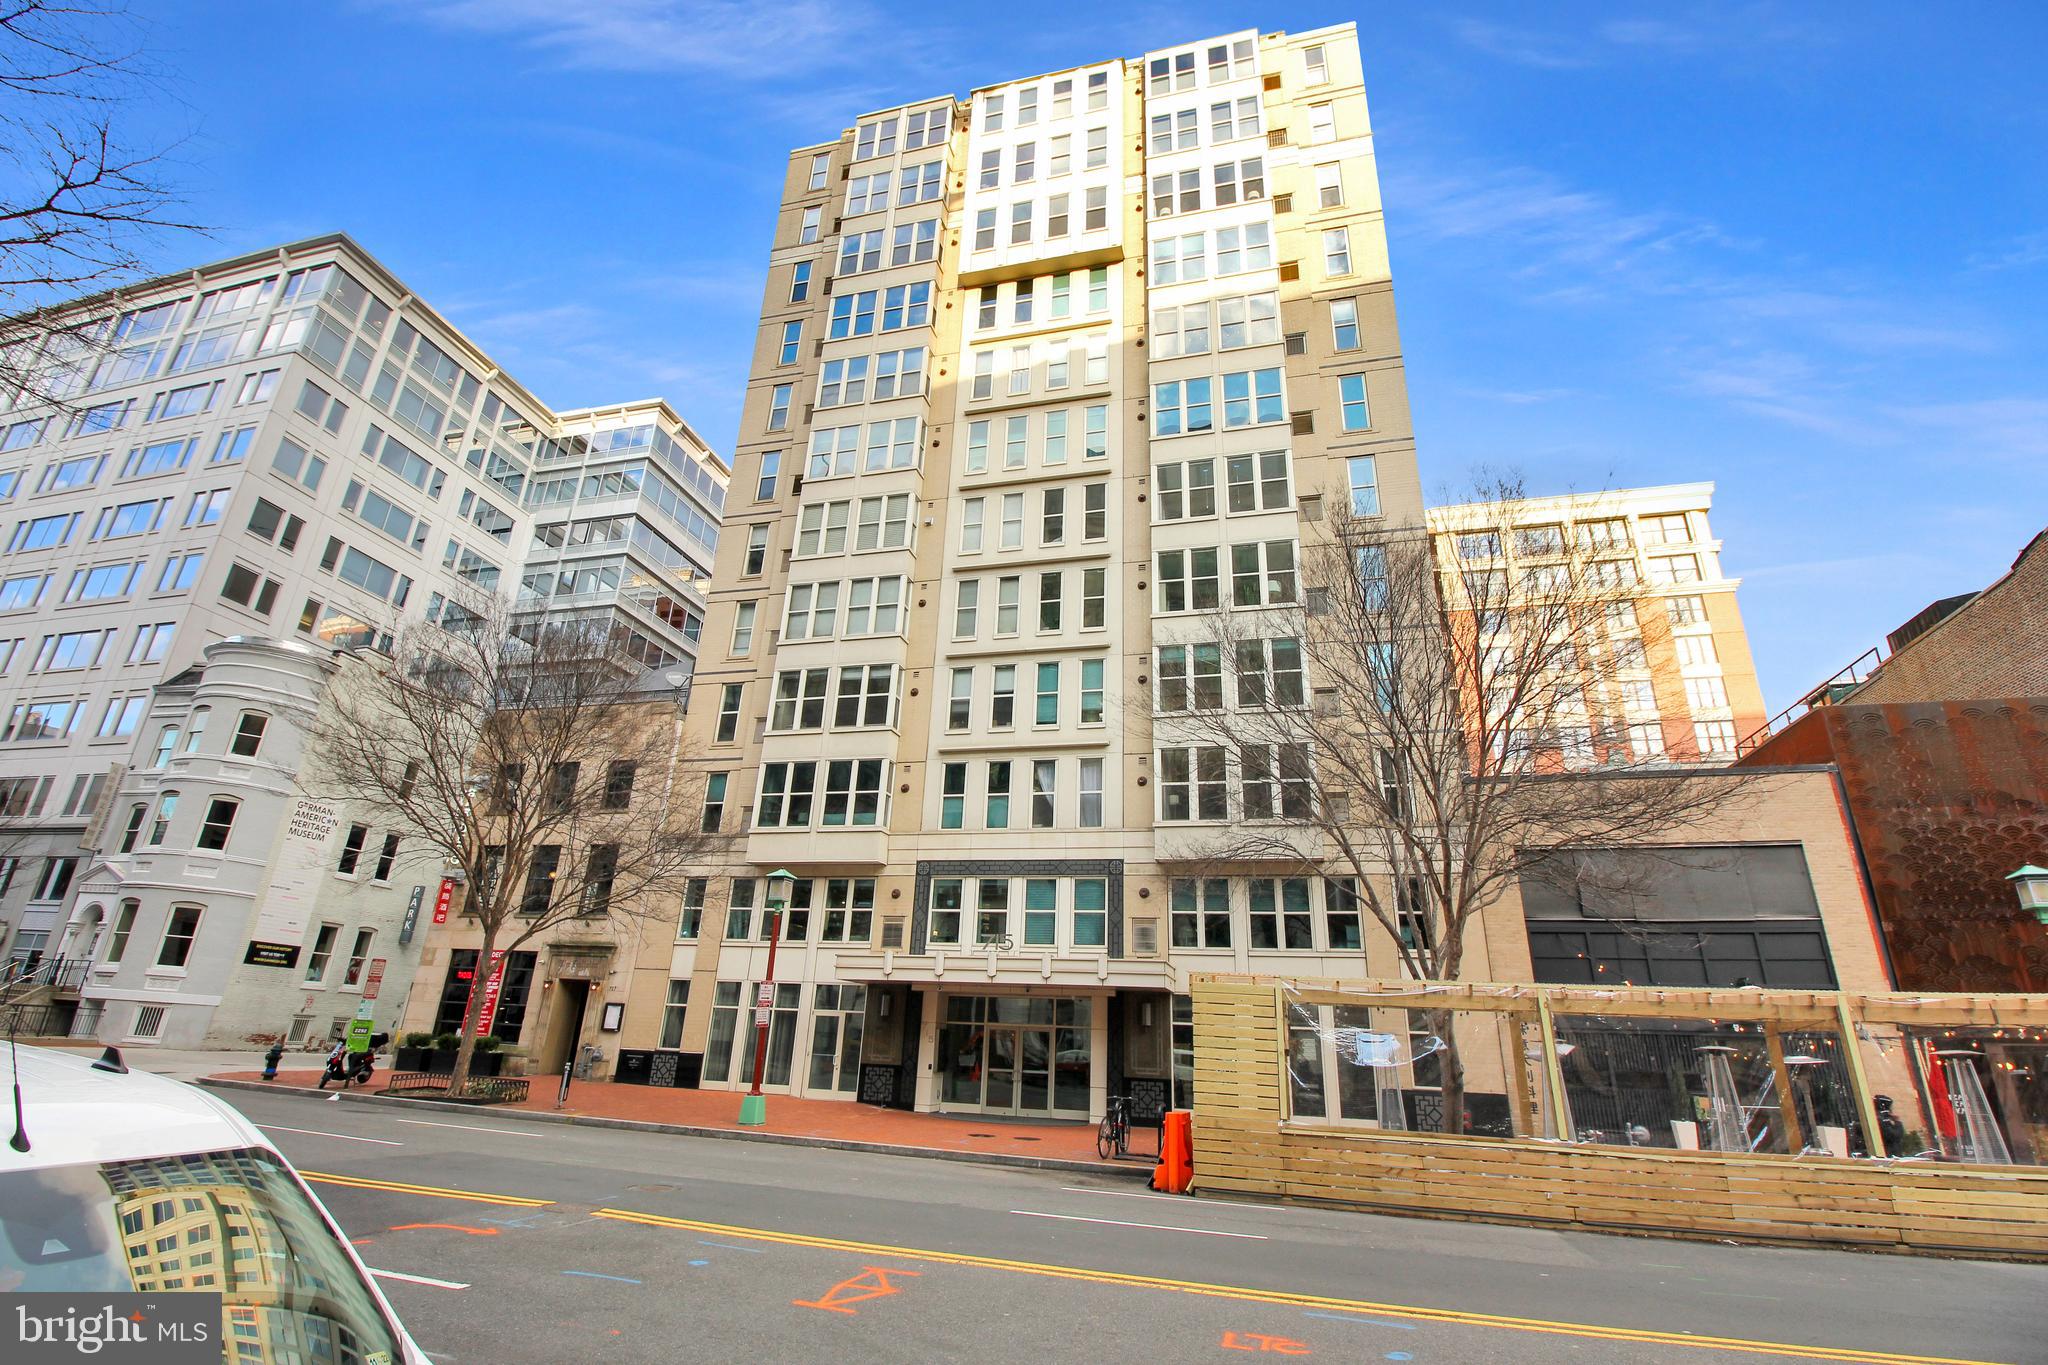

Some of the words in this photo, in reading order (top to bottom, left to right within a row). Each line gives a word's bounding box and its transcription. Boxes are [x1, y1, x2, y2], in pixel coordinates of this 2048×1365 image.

[288, 827, 325, 842] MUSEUM
[291, 818, 331, 834] HERITAGE
[404, 886, 421, 930] PARK
[981, 933, 1014, 951] 715
